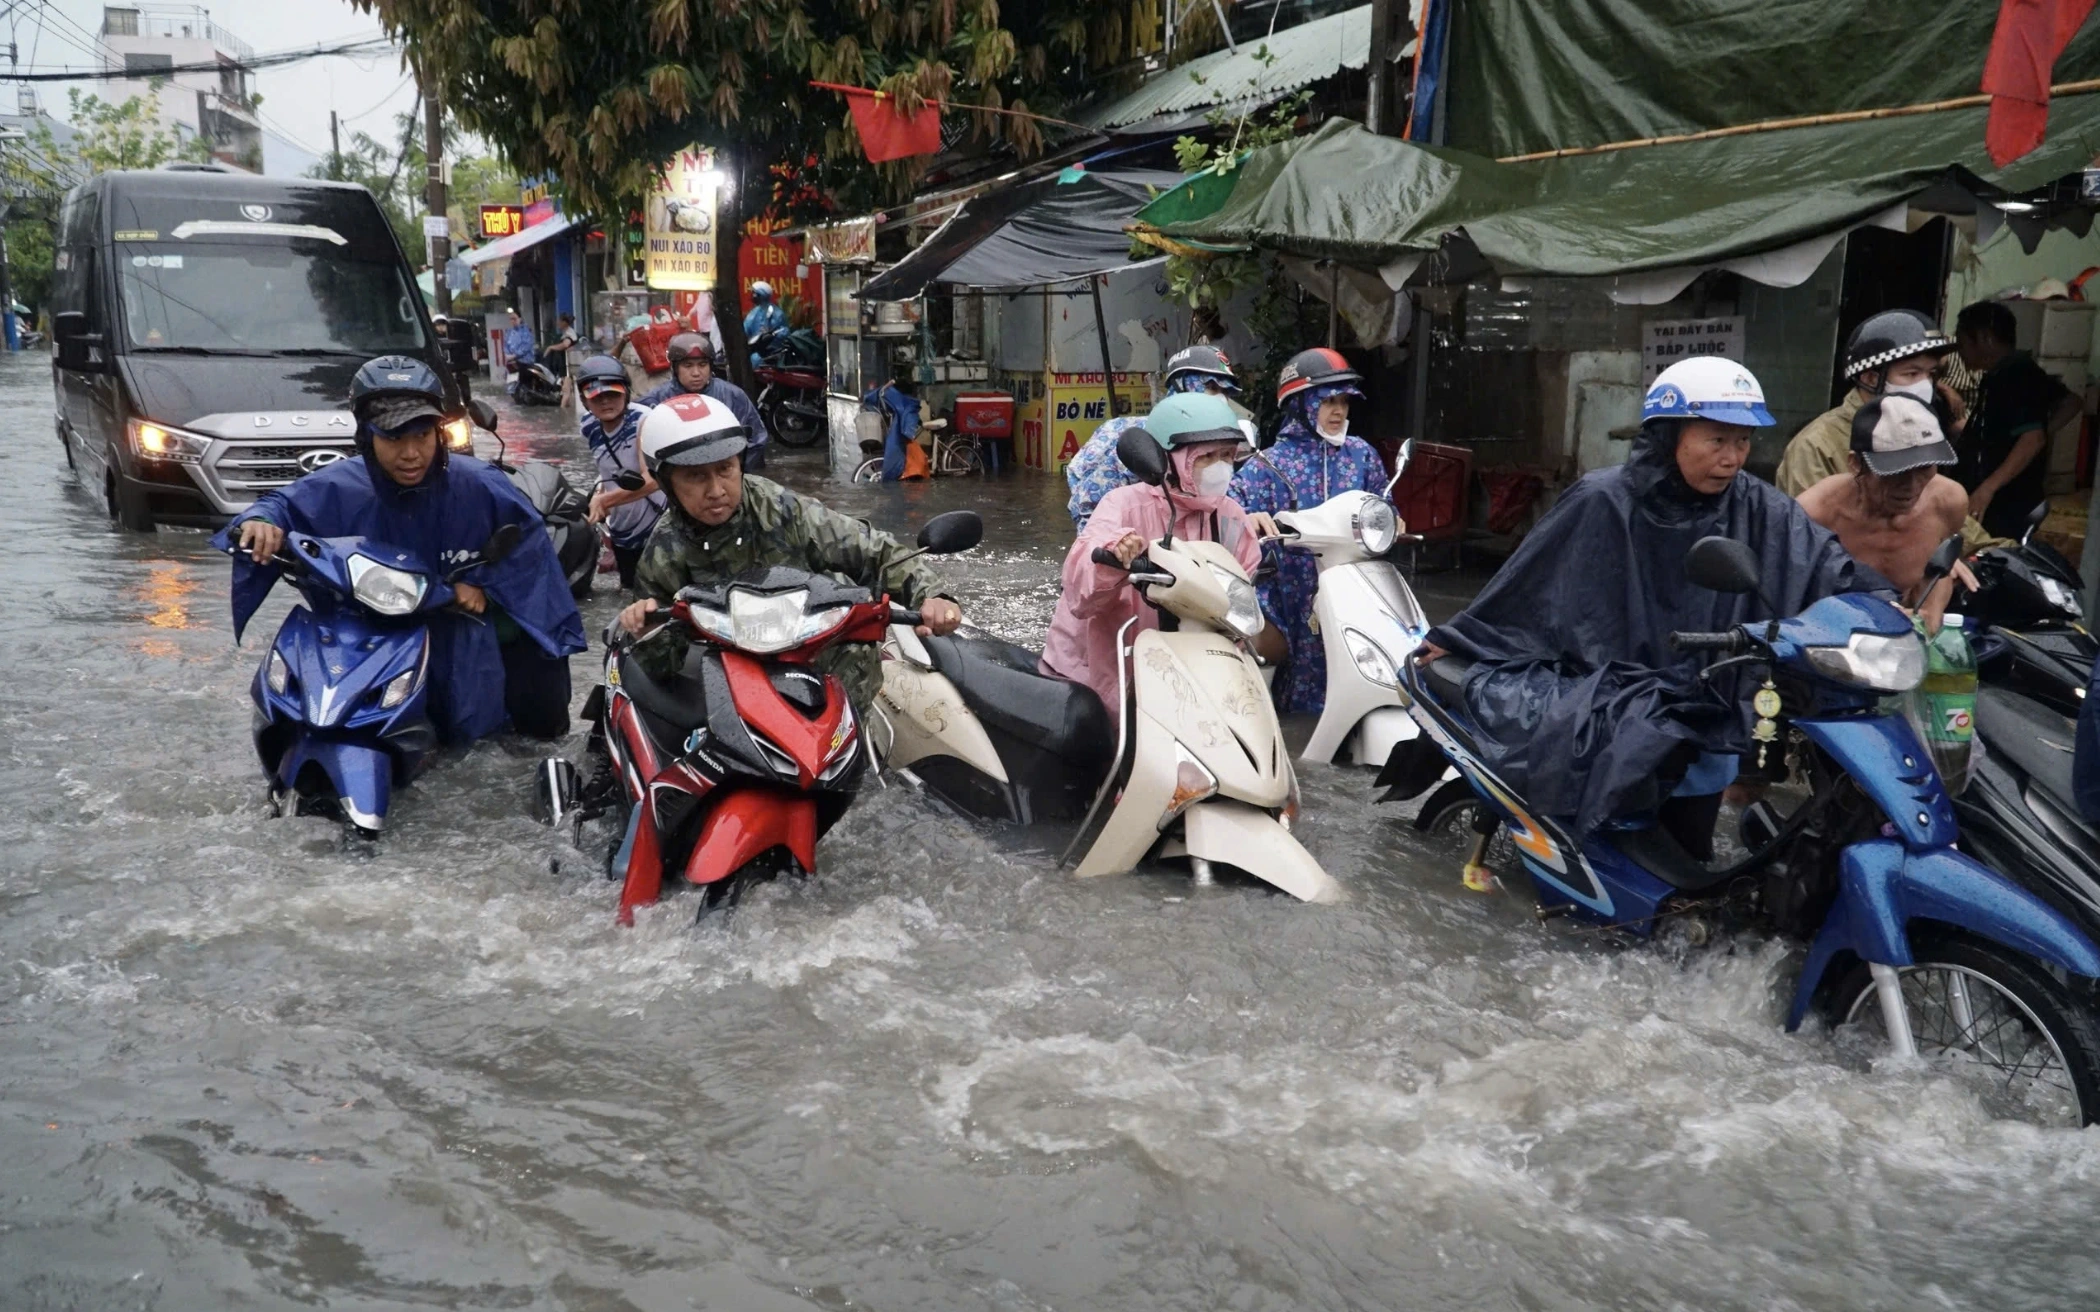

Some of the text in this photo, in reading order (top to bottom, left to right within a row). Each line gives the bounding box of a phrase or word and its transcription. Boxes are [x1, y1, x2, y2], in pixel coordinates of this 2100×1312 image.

[483, 207, 520, 233] THÚ Y
[650, 239, 669, 252] NUI
[753, 242, 789, 265] TIỀN
[744, 277, 802, 294] NANH
[1056, 396, 1107, 419] BÒ NÉ
[784, 672, 821, 686] HONDA
[698, 750, 725, 774] HONDA
